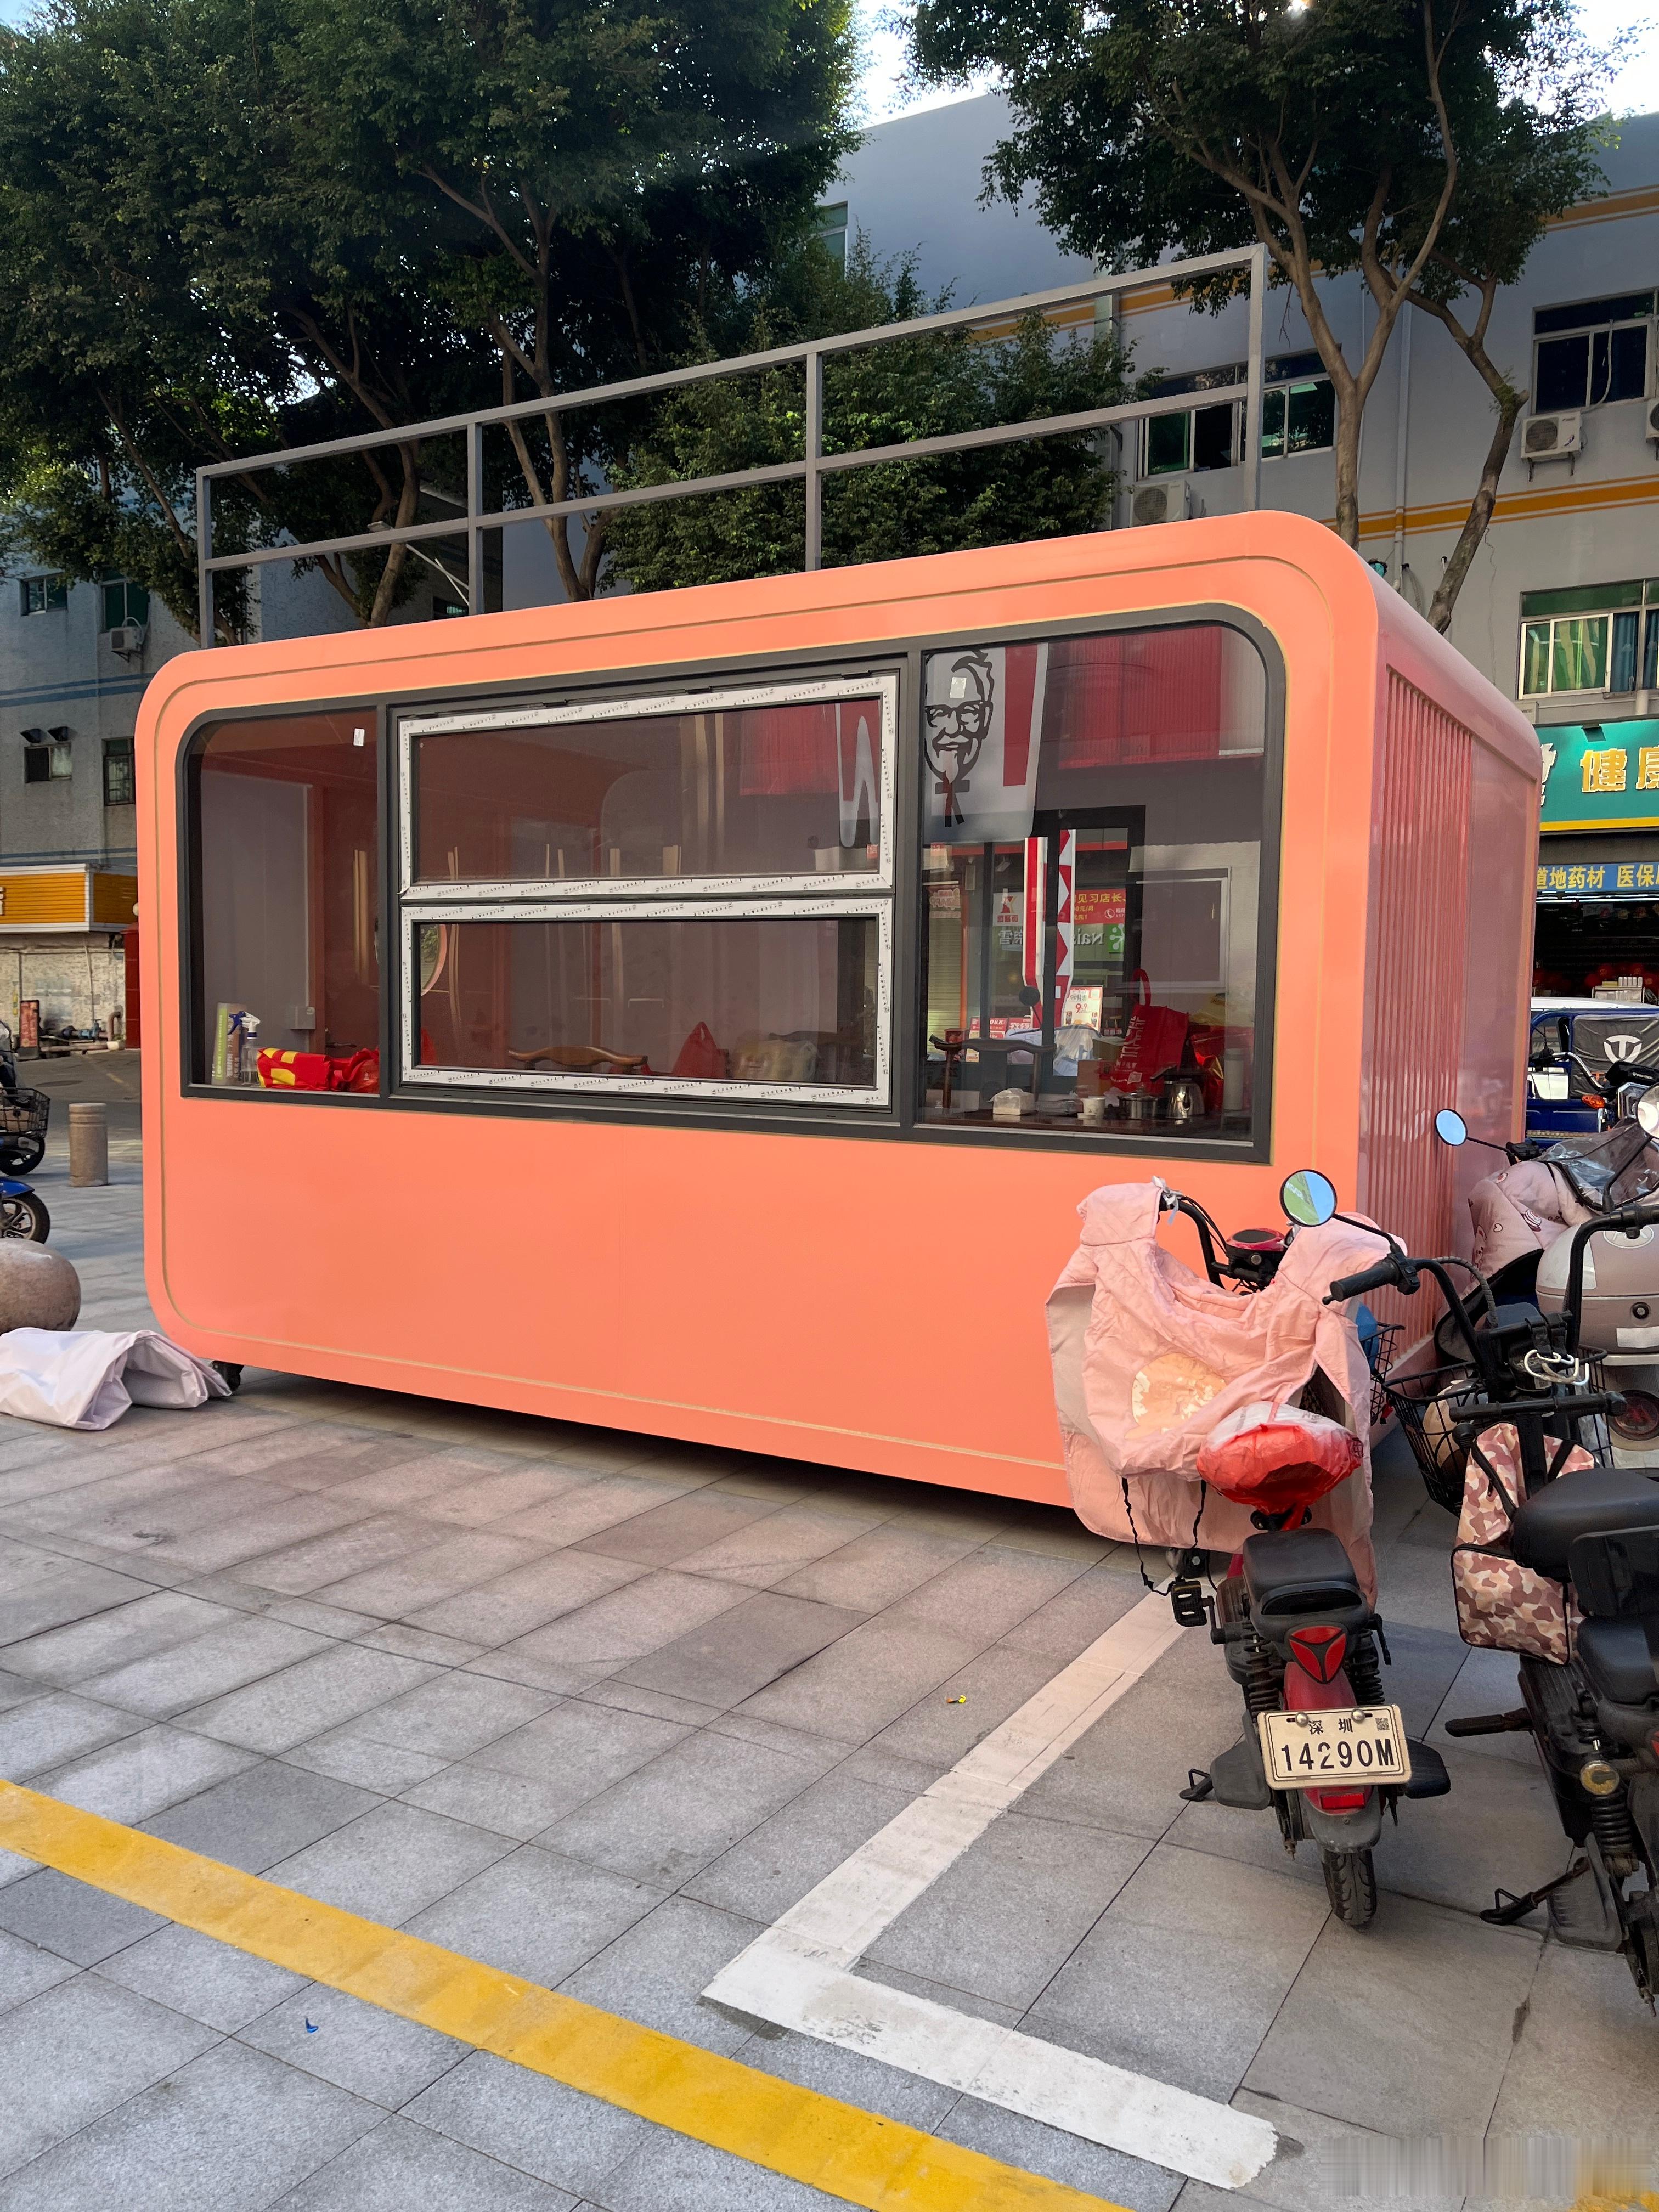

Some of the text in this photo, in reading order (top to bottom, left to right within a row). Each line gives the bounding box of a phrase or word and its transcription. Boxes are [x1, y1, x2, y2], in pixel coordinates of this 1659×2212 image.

[1617, 864, 1659, 888] 医保
[1075, 893, 1126, 903] 见习店长、
[1308, 1718, 1353, 1735] 深圳
[1280, 1738, 1395, 1771] 14290M
